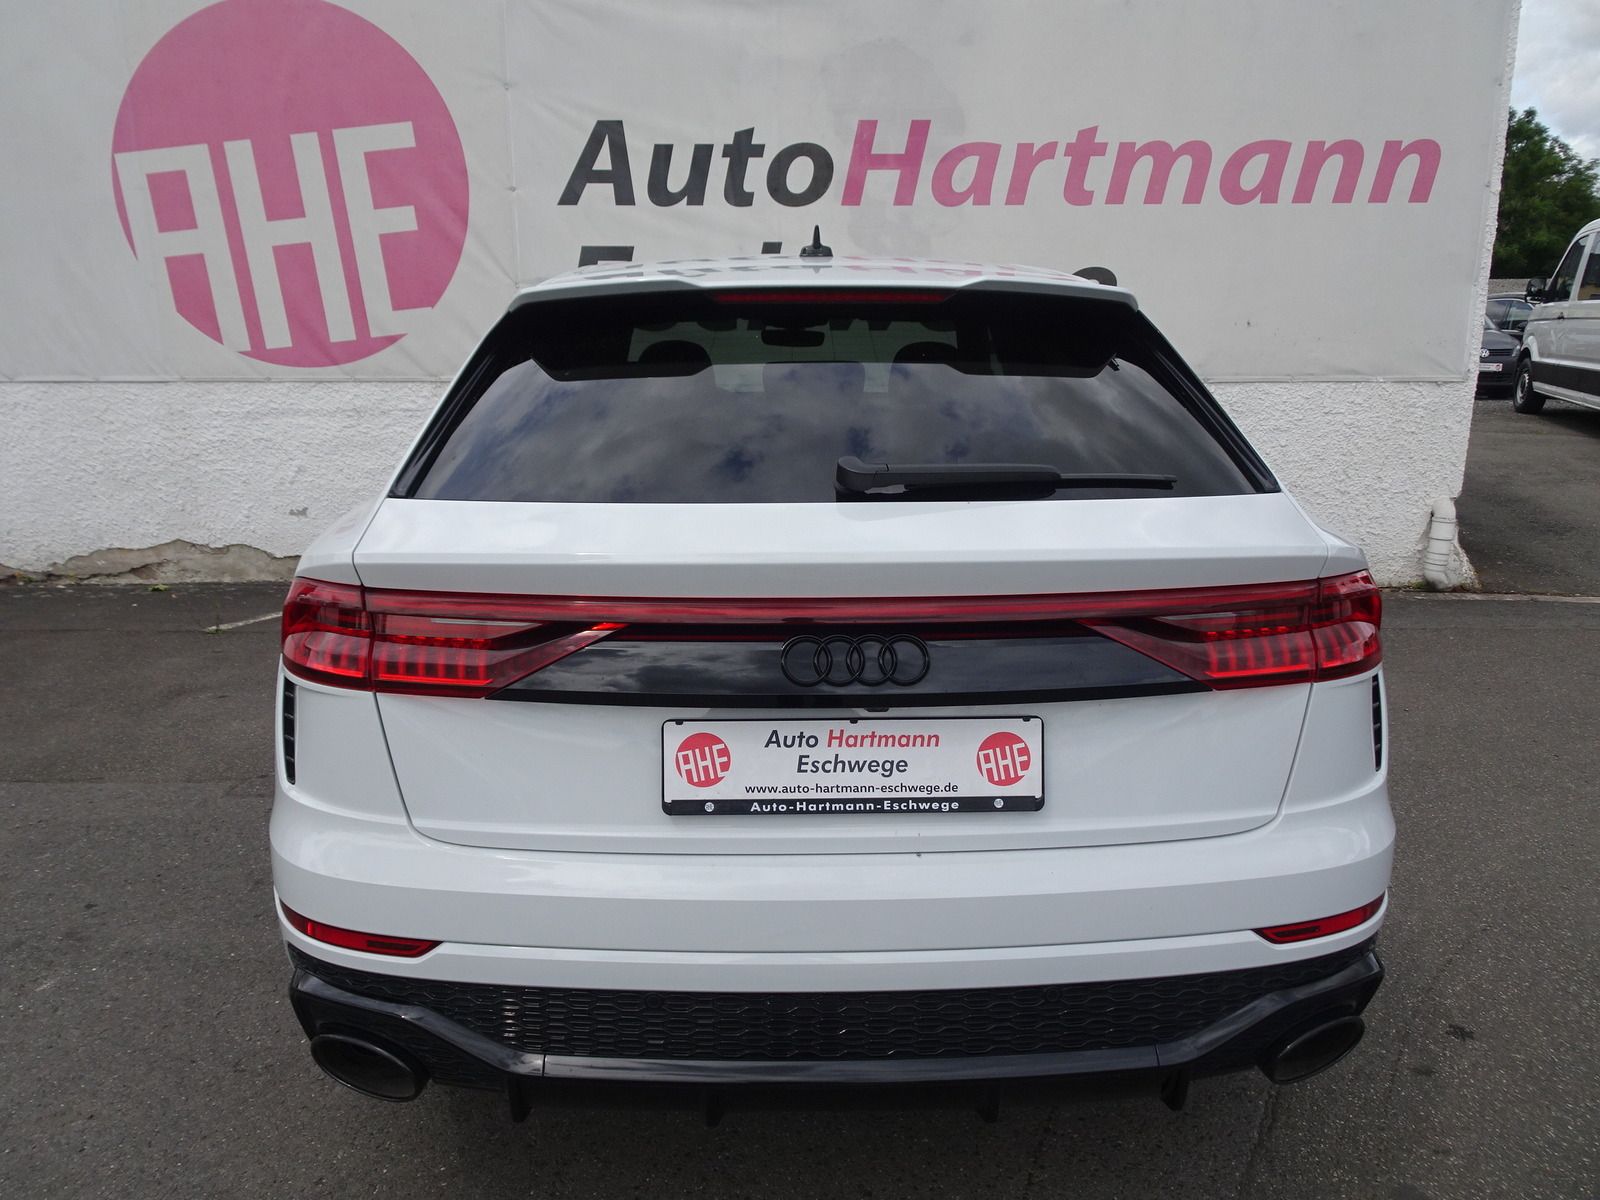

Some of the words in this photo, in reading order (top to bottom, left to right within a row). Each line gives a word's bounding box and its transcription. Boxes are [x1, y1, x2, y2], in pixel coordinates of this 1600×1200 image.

[113, 120, 434, 354] AHE
[764, 729, 819, 748] Auto
[827, 728, 940, 748] Hartmann
[677, 743, 731, 783] AHE
[797, 754, 908, 777] Eschwege
[978, 742, 1030, 782] AHE
[745, 783, 959, 795] www.auto-hartmann-eschwege.de
[750, 800, 960, 812] Auto-Hartmann-Eschwege
